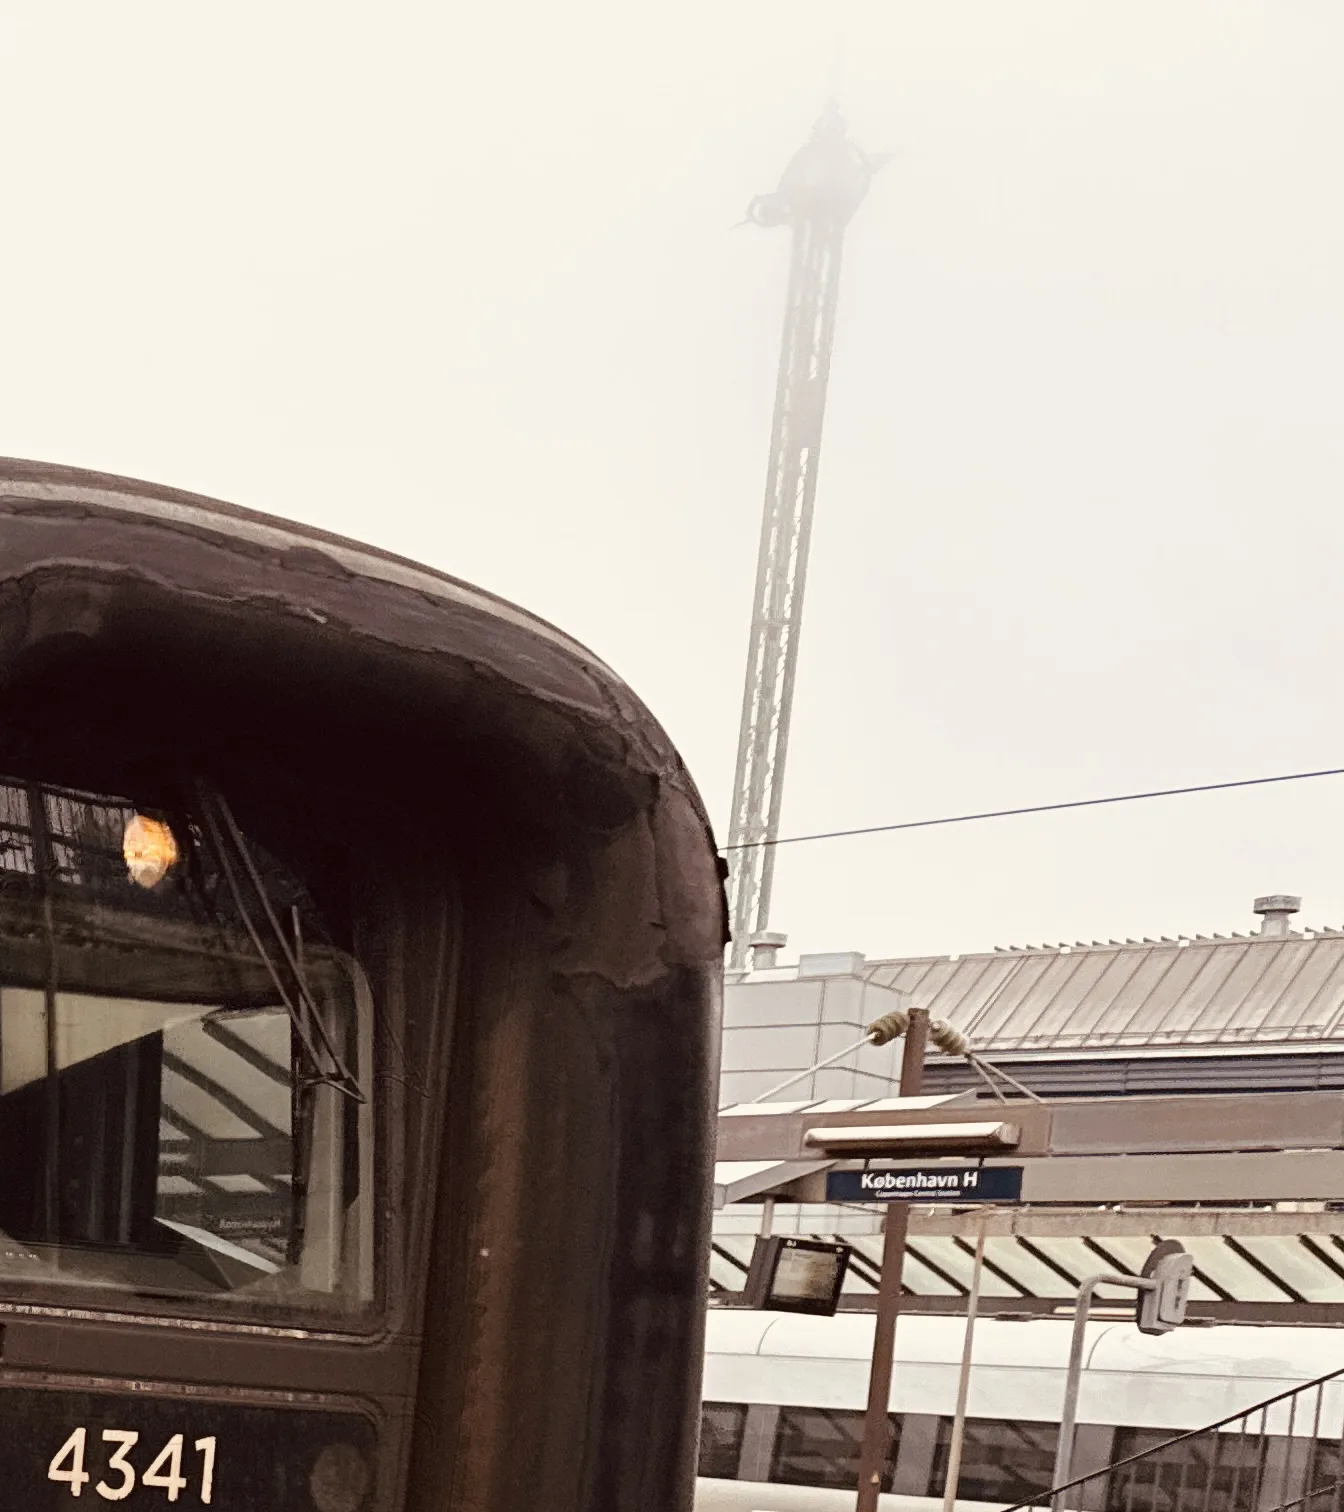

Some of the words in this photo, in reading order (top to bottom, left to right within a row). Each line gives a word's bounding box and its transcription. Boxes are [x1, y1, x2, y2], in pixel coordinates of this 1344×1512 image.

[861, 1172, 959, 1190] København
[963, 1171, 978, 1187] H
[47, 1427, 218, 1504] 4341
